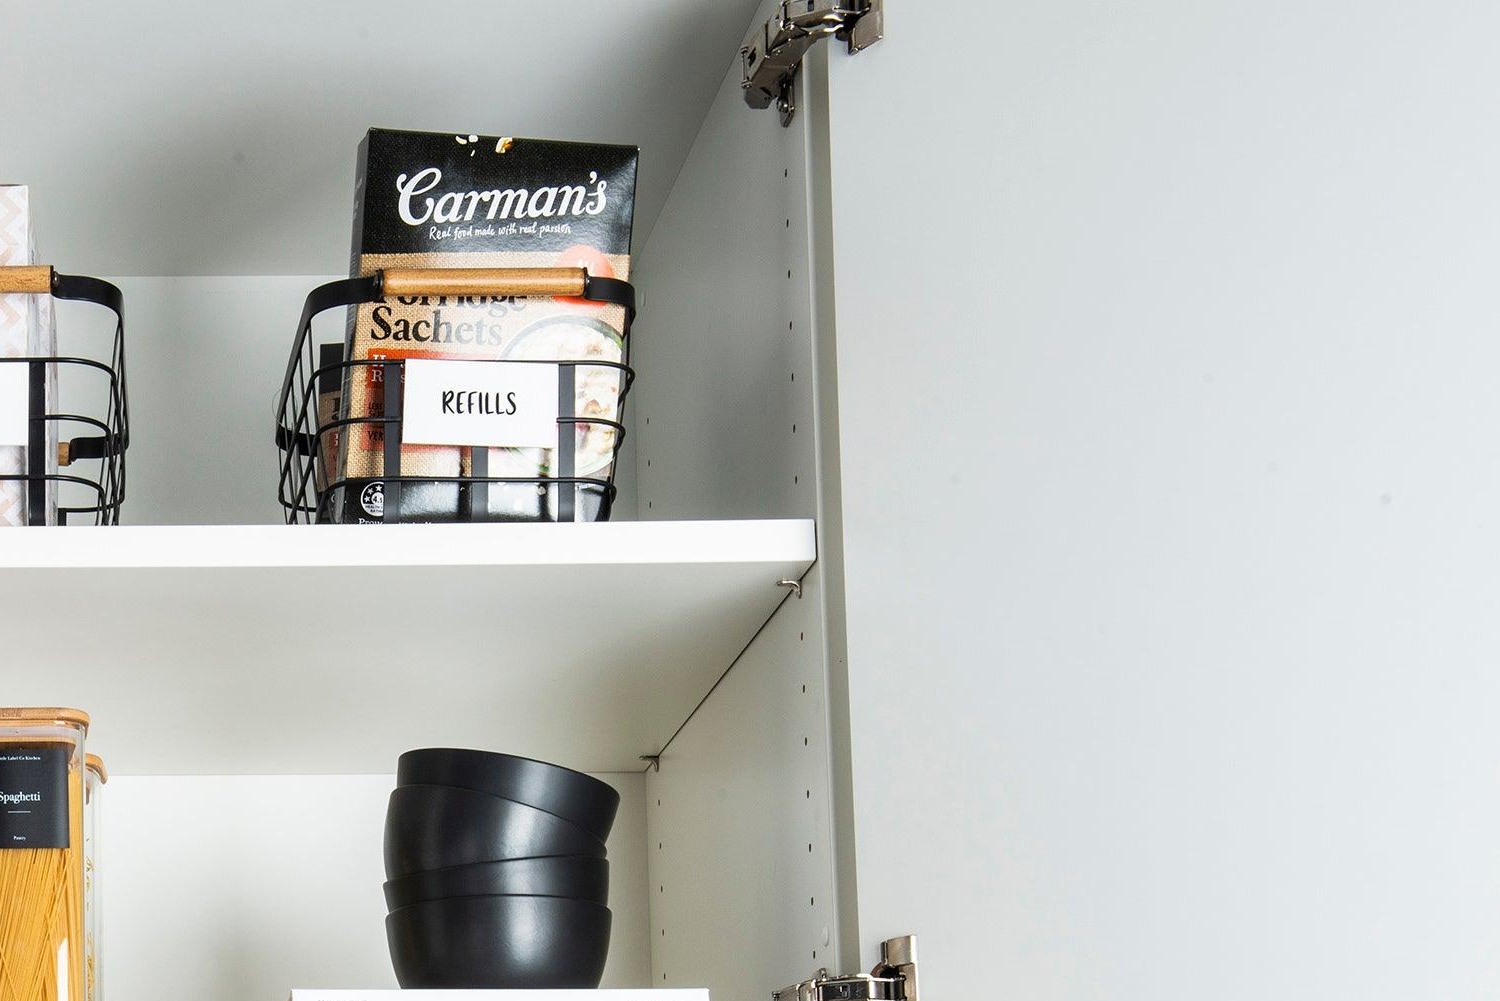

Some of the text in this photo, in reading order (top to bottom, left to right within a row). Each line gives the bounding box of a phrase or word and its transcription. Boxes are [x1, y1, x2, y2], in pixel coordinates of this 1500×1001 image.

[396, 167, 608, 226] Carman's
[429, 222, 572, 240] Real food made with real passion
[371, 306, 502, 346] Sachets
[441, 390, 518, 416] REFILLS
